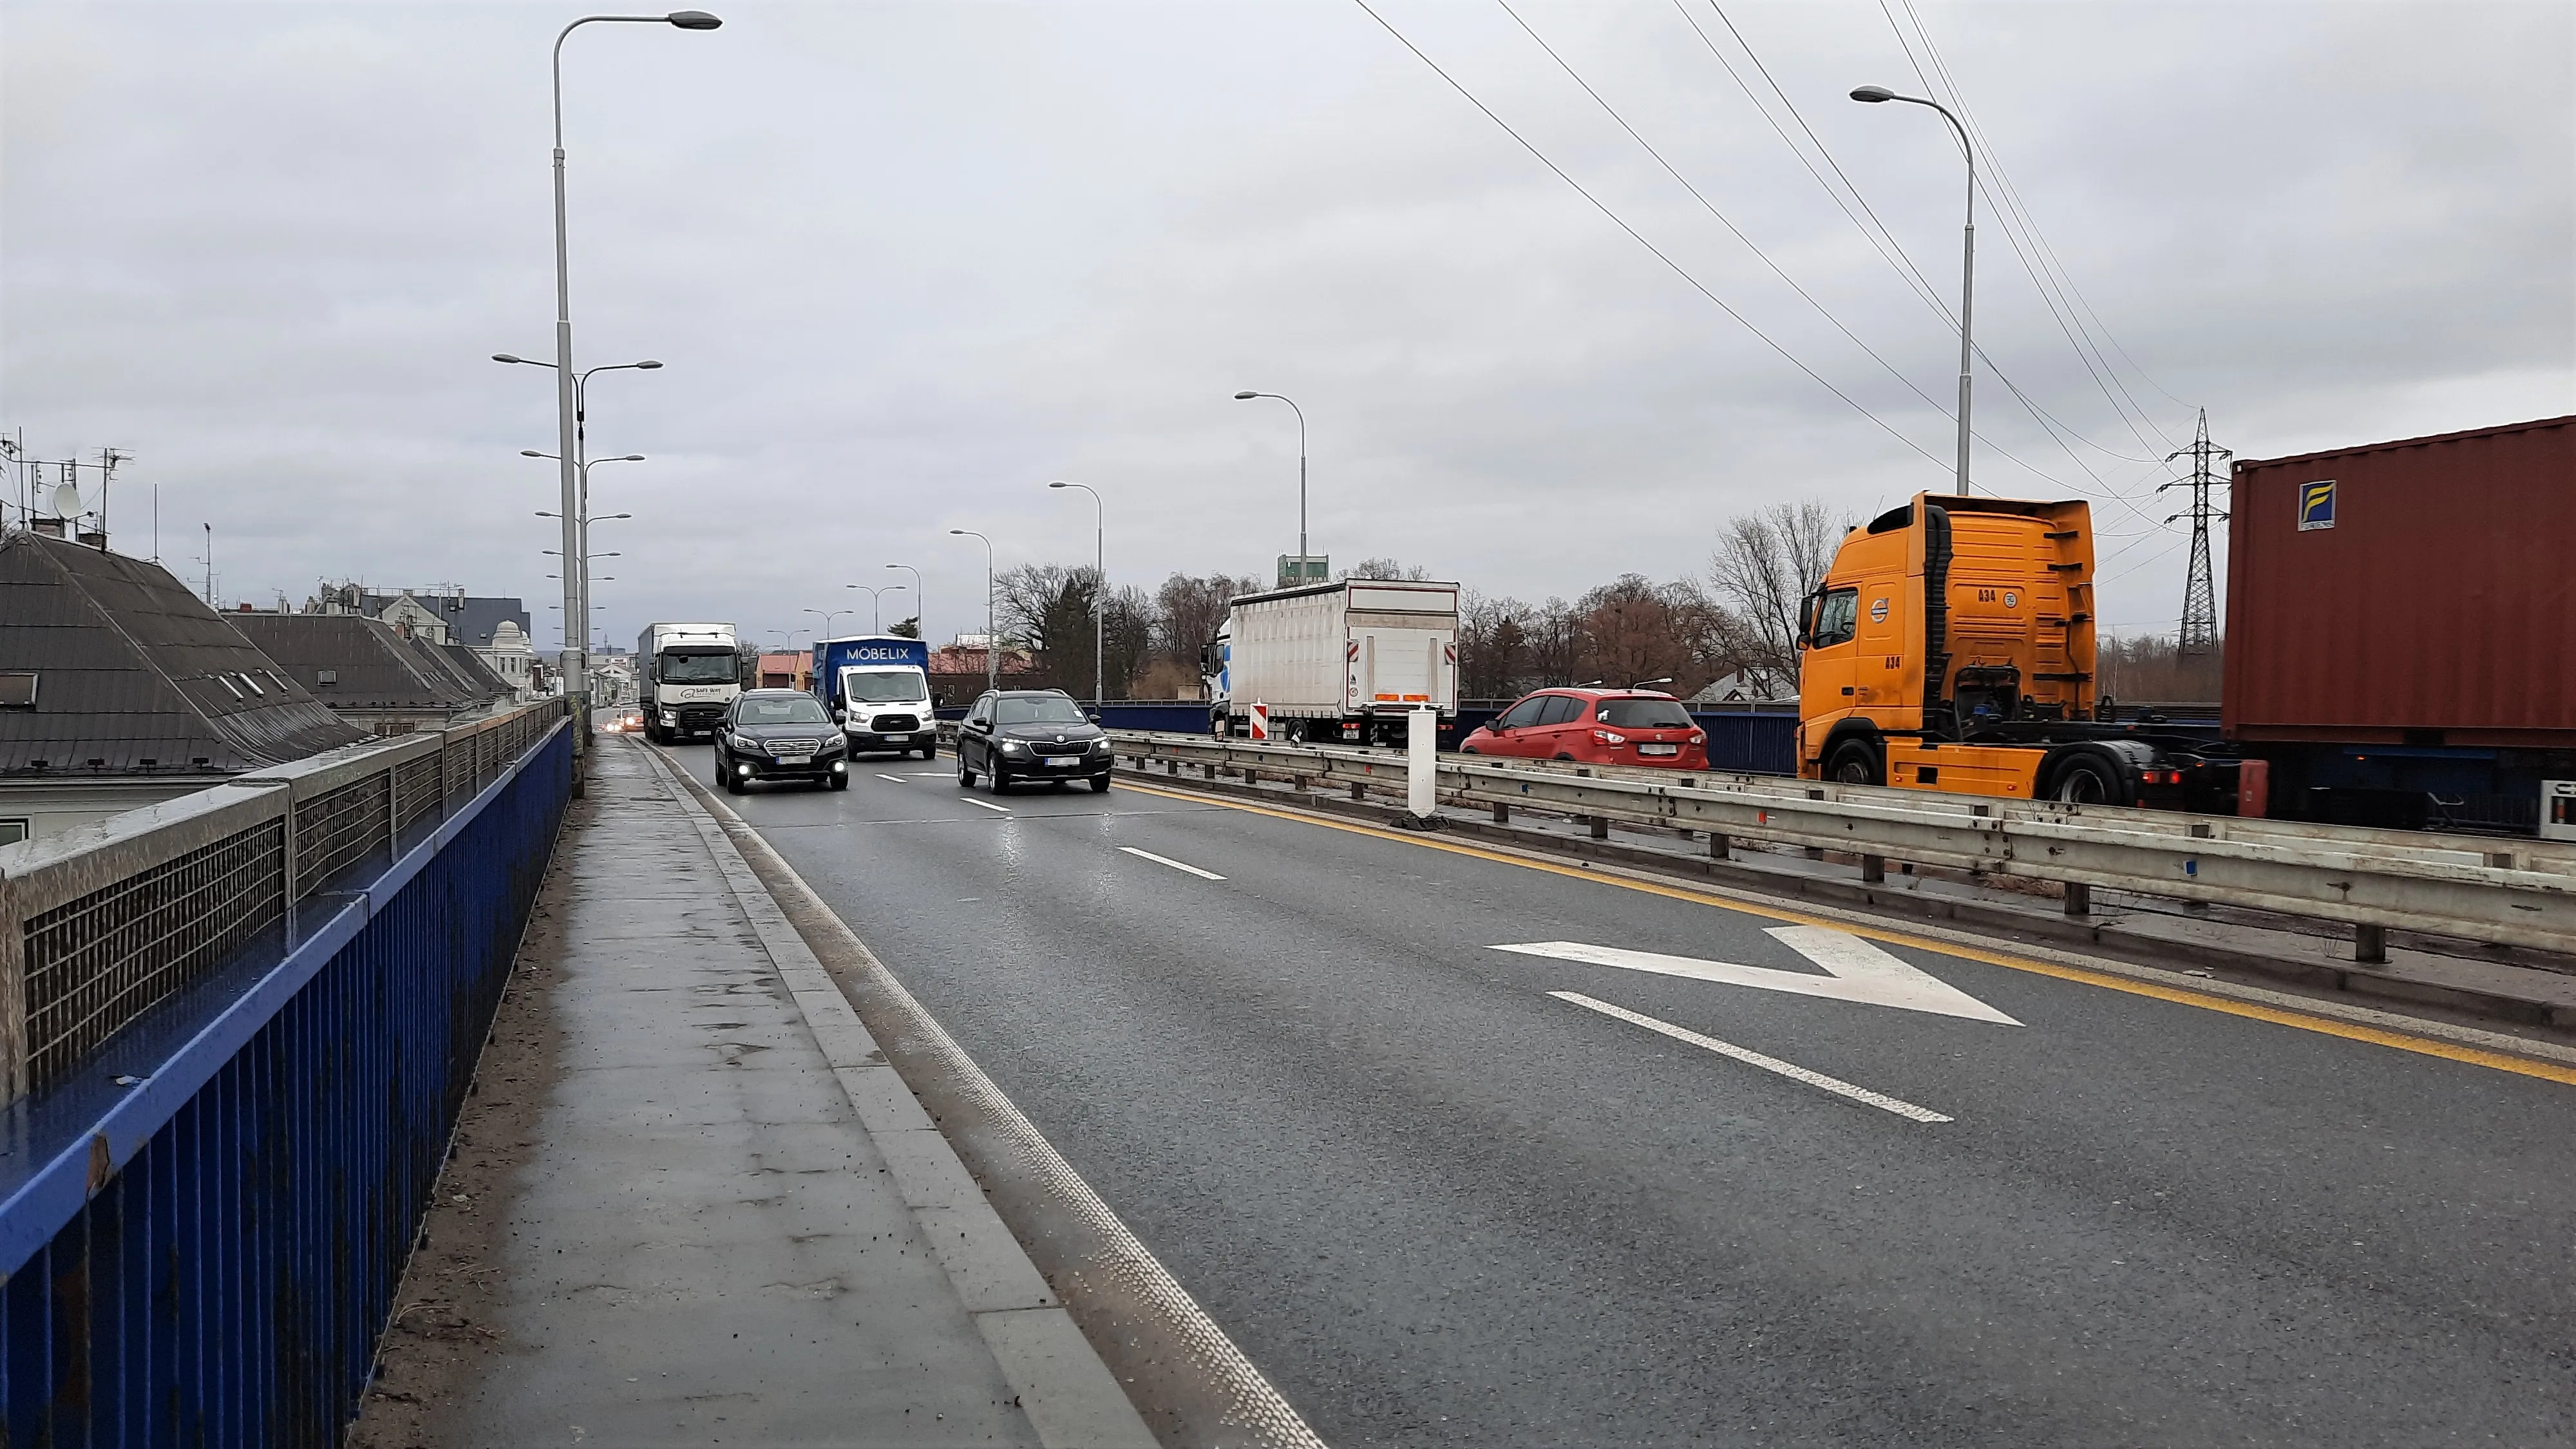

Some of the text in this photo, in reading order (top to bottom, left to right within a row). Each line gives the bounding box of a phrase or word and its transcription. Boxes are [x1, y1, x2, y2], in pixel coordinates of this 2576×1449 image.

[1979, 589, 1996, 603] A34
[847, 646, 909, 660] MÖBELIX
[1885, 656, 1900, 670] A34
